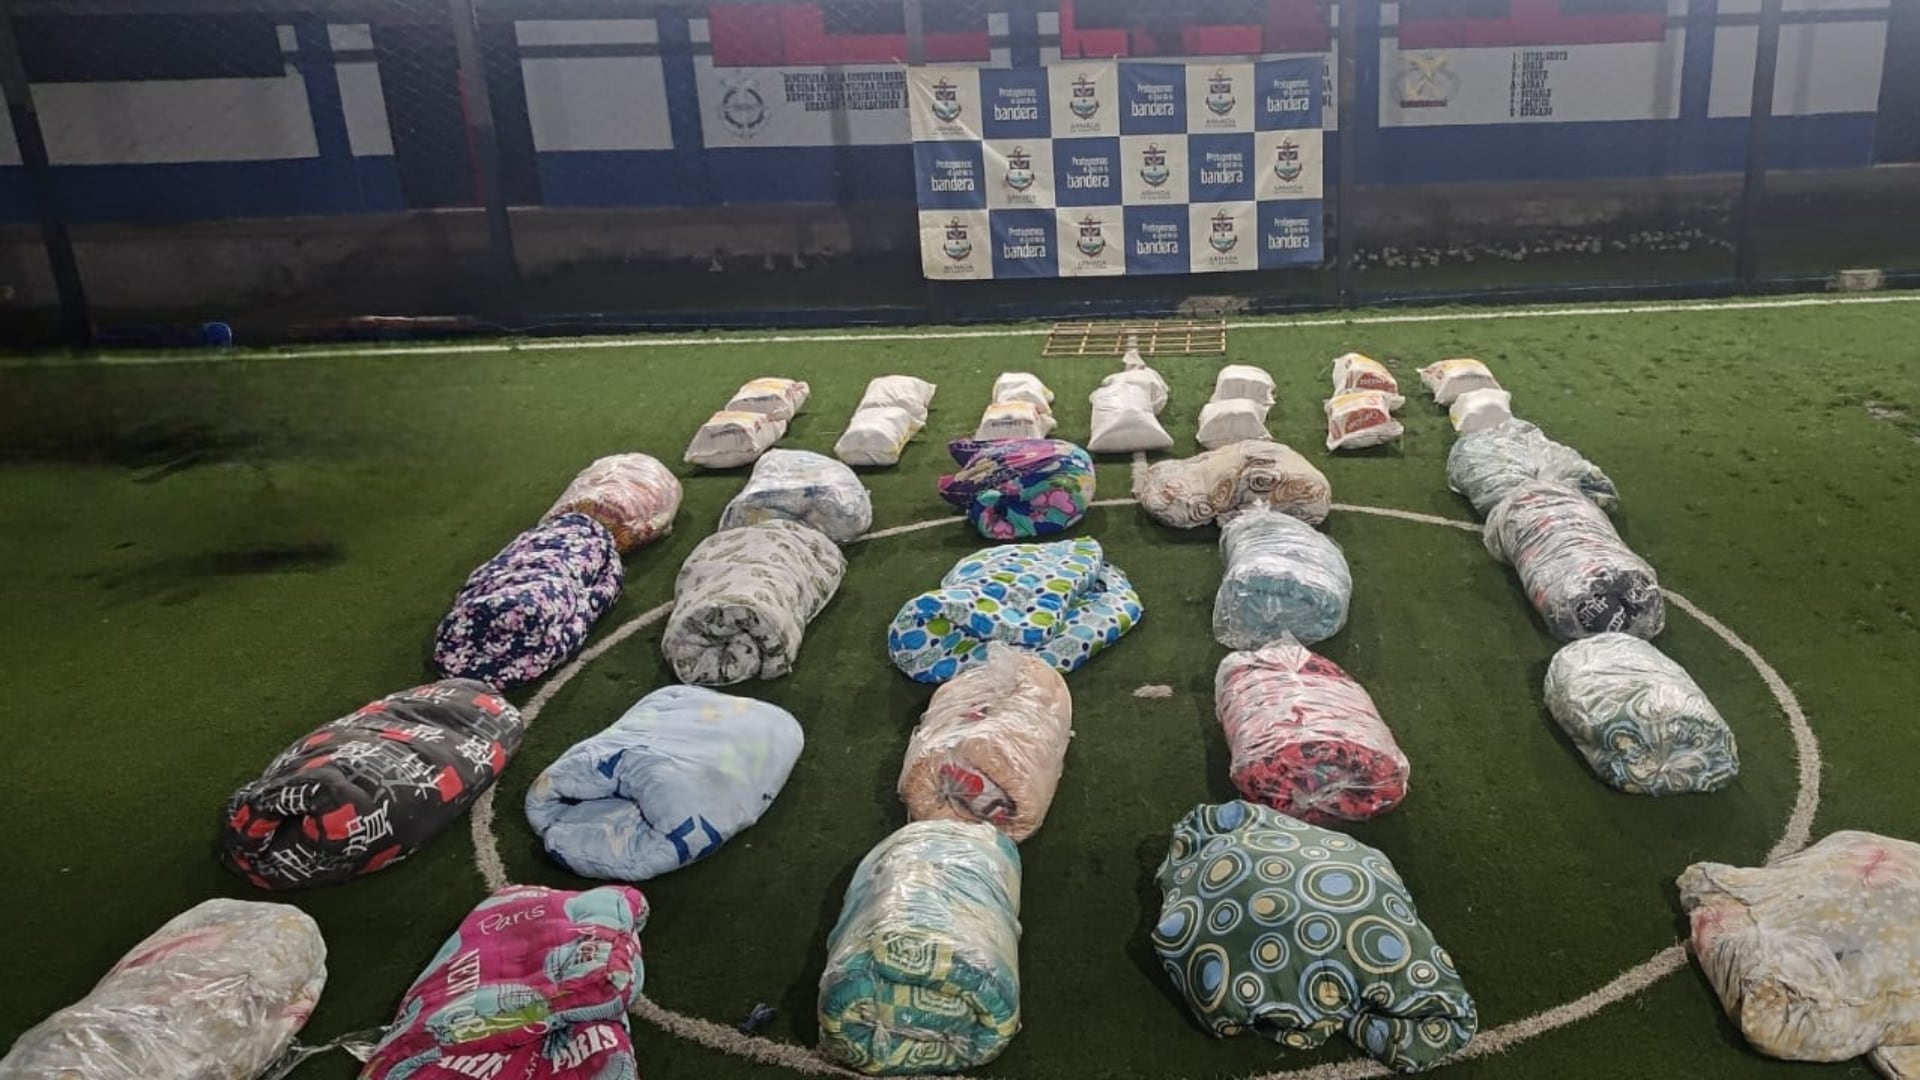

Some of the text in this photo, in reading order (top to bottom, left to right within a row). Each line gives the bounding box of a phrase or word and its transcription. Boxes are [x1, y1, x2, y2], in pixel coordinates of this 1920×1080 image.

[994, 104, 1038, 120] bandera
[1131, 100, 1174, 116] bandera
[1267, 96, 1309, 112] bandera
[931, 175, 974, 191] bandera
[1066, 172, 1109, 188] bandera
[1201, 168, 1243, 184] bandera
[1137, 240, 1178, 254] bandera
[1268, 233, 1310, 249] bandera
[1003, 243, 1046, 258] bandera
[479, 904, 546, 935] Paris
[446, 949, 480, 996] NEW
[551, 1024, 619, 1074] PARIS
